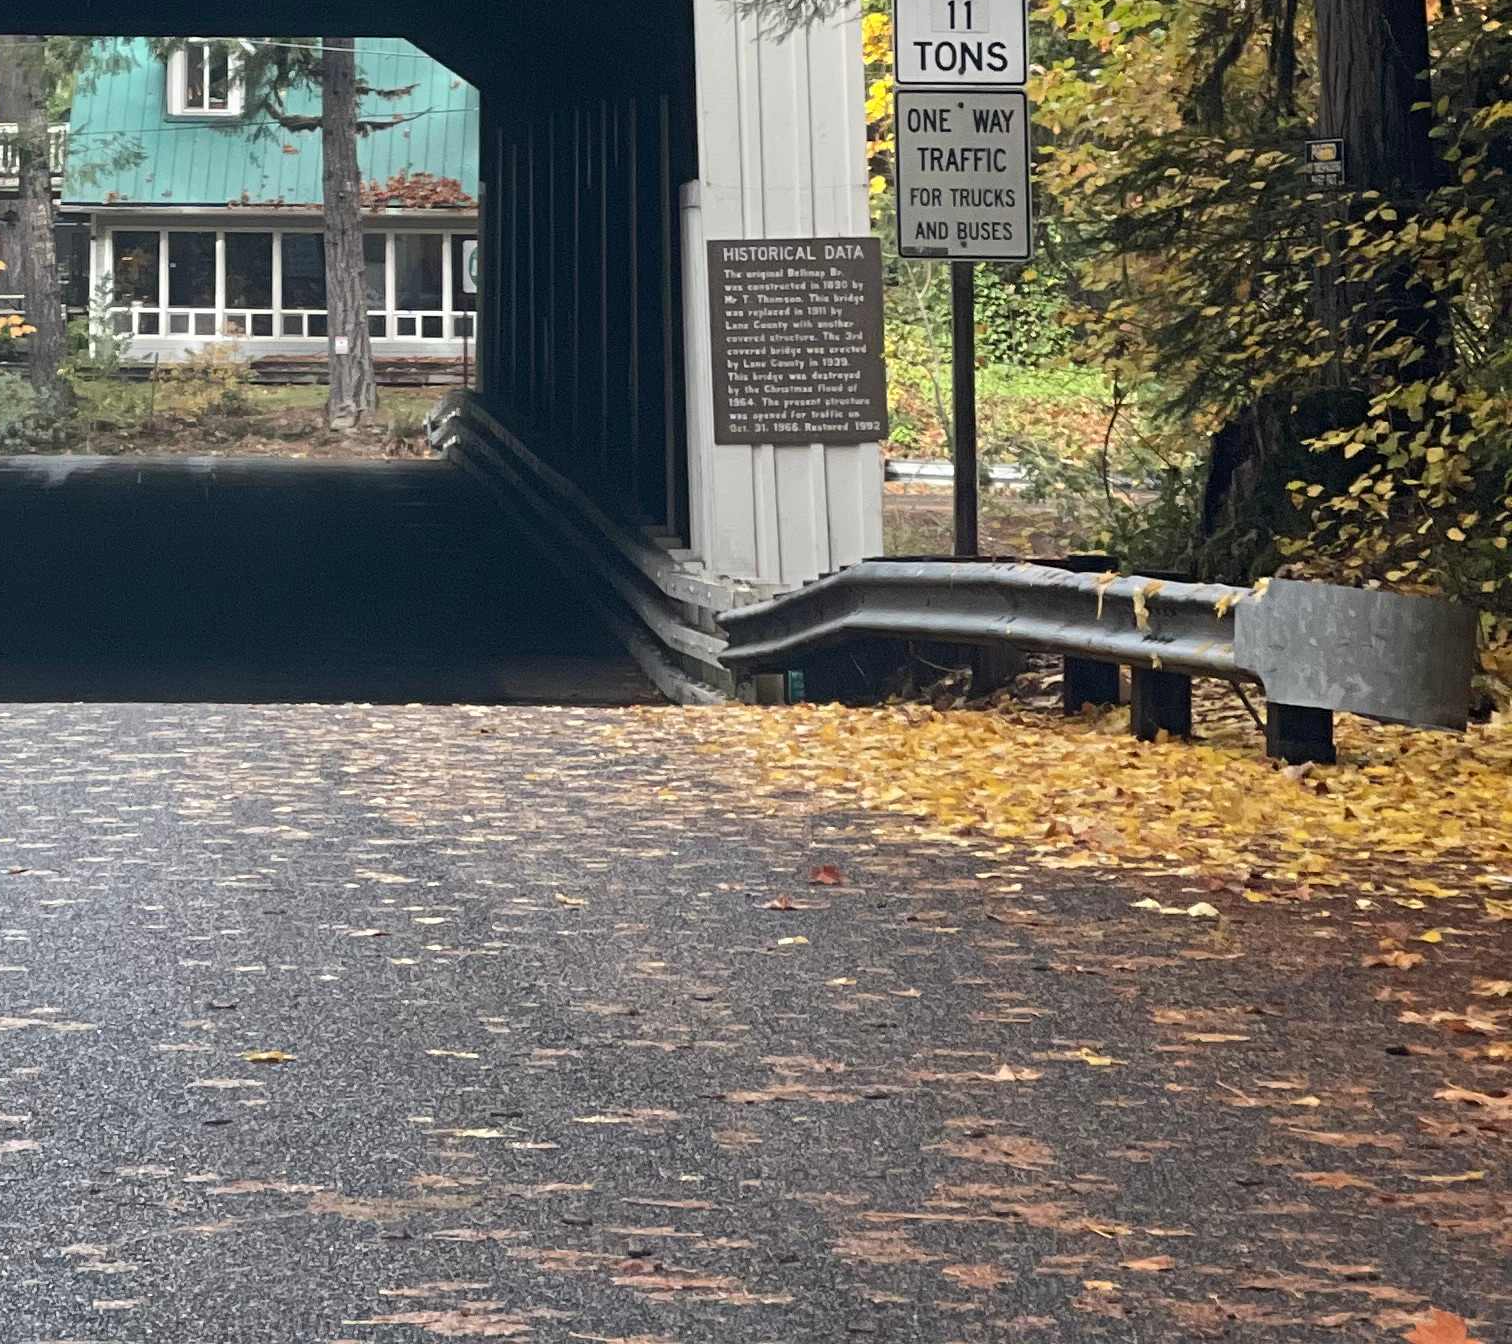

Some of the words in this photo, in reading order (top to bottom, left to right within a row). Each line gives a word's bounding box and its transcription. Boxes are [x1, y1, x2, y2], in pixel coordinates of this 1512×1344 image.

[948, 0, 972, 30] 11
[913, 41, 1008, 72] TONS
[907, 108, 952, 133] ONE
[973, 109, 1015, 133] WAY
[917, 147, 1007, 172] TRAFFIC
[910, 188, 942, 207] FOR
[950, 188, 1016, 207] TRUCKS
[915, 222, 948, 240] AND
[957, 222, 1013, 240] BUSES
[723, 246, 816, 261] HISTORICAL
[824, 245, 864, 259] DATA
[724, 269, 741, 278] The
[747, 282, 806, 291] constructed
[852, 281, 863, 291] by
[809, 294, 829, 302] This
[834, 294, 864, 305] bridge
[794, 307, 803, 316] in
[831, 307, 842, 317] by
[753, 320, 788, 331] County
[793, 320, 813, 328] with
[726, 334, 765, 342] covered
[822, 331, 840, 340] The
[845, 332, 863, 340] 3rd
[727, 347, 766, 355] covered
[770, 346, 801, 356] bridge
[727, 359, 739, 370] by
[770, 359, 804, 369] County
[809, 358, 818, 366] in
[727, 372, 748, 381] This
[753, 372, 783, 382] bridge
[812, 371, 861, 382] destroyed
[727, 386, 739, 396] by
[744, 385, 759, 394] the
[764, 384, 813, 393] Christmas
[818, 384, 843, 393] flood
[847, 384, 857, 392] of
[762, 397, 779, 406] The
[784, 398, 821, 408] present
[825, 397, 870, 406] structure
[753, 411, 786, 422] opened
[790, 411, 806, 419] for
[811, 410, 843, 418] traffic
